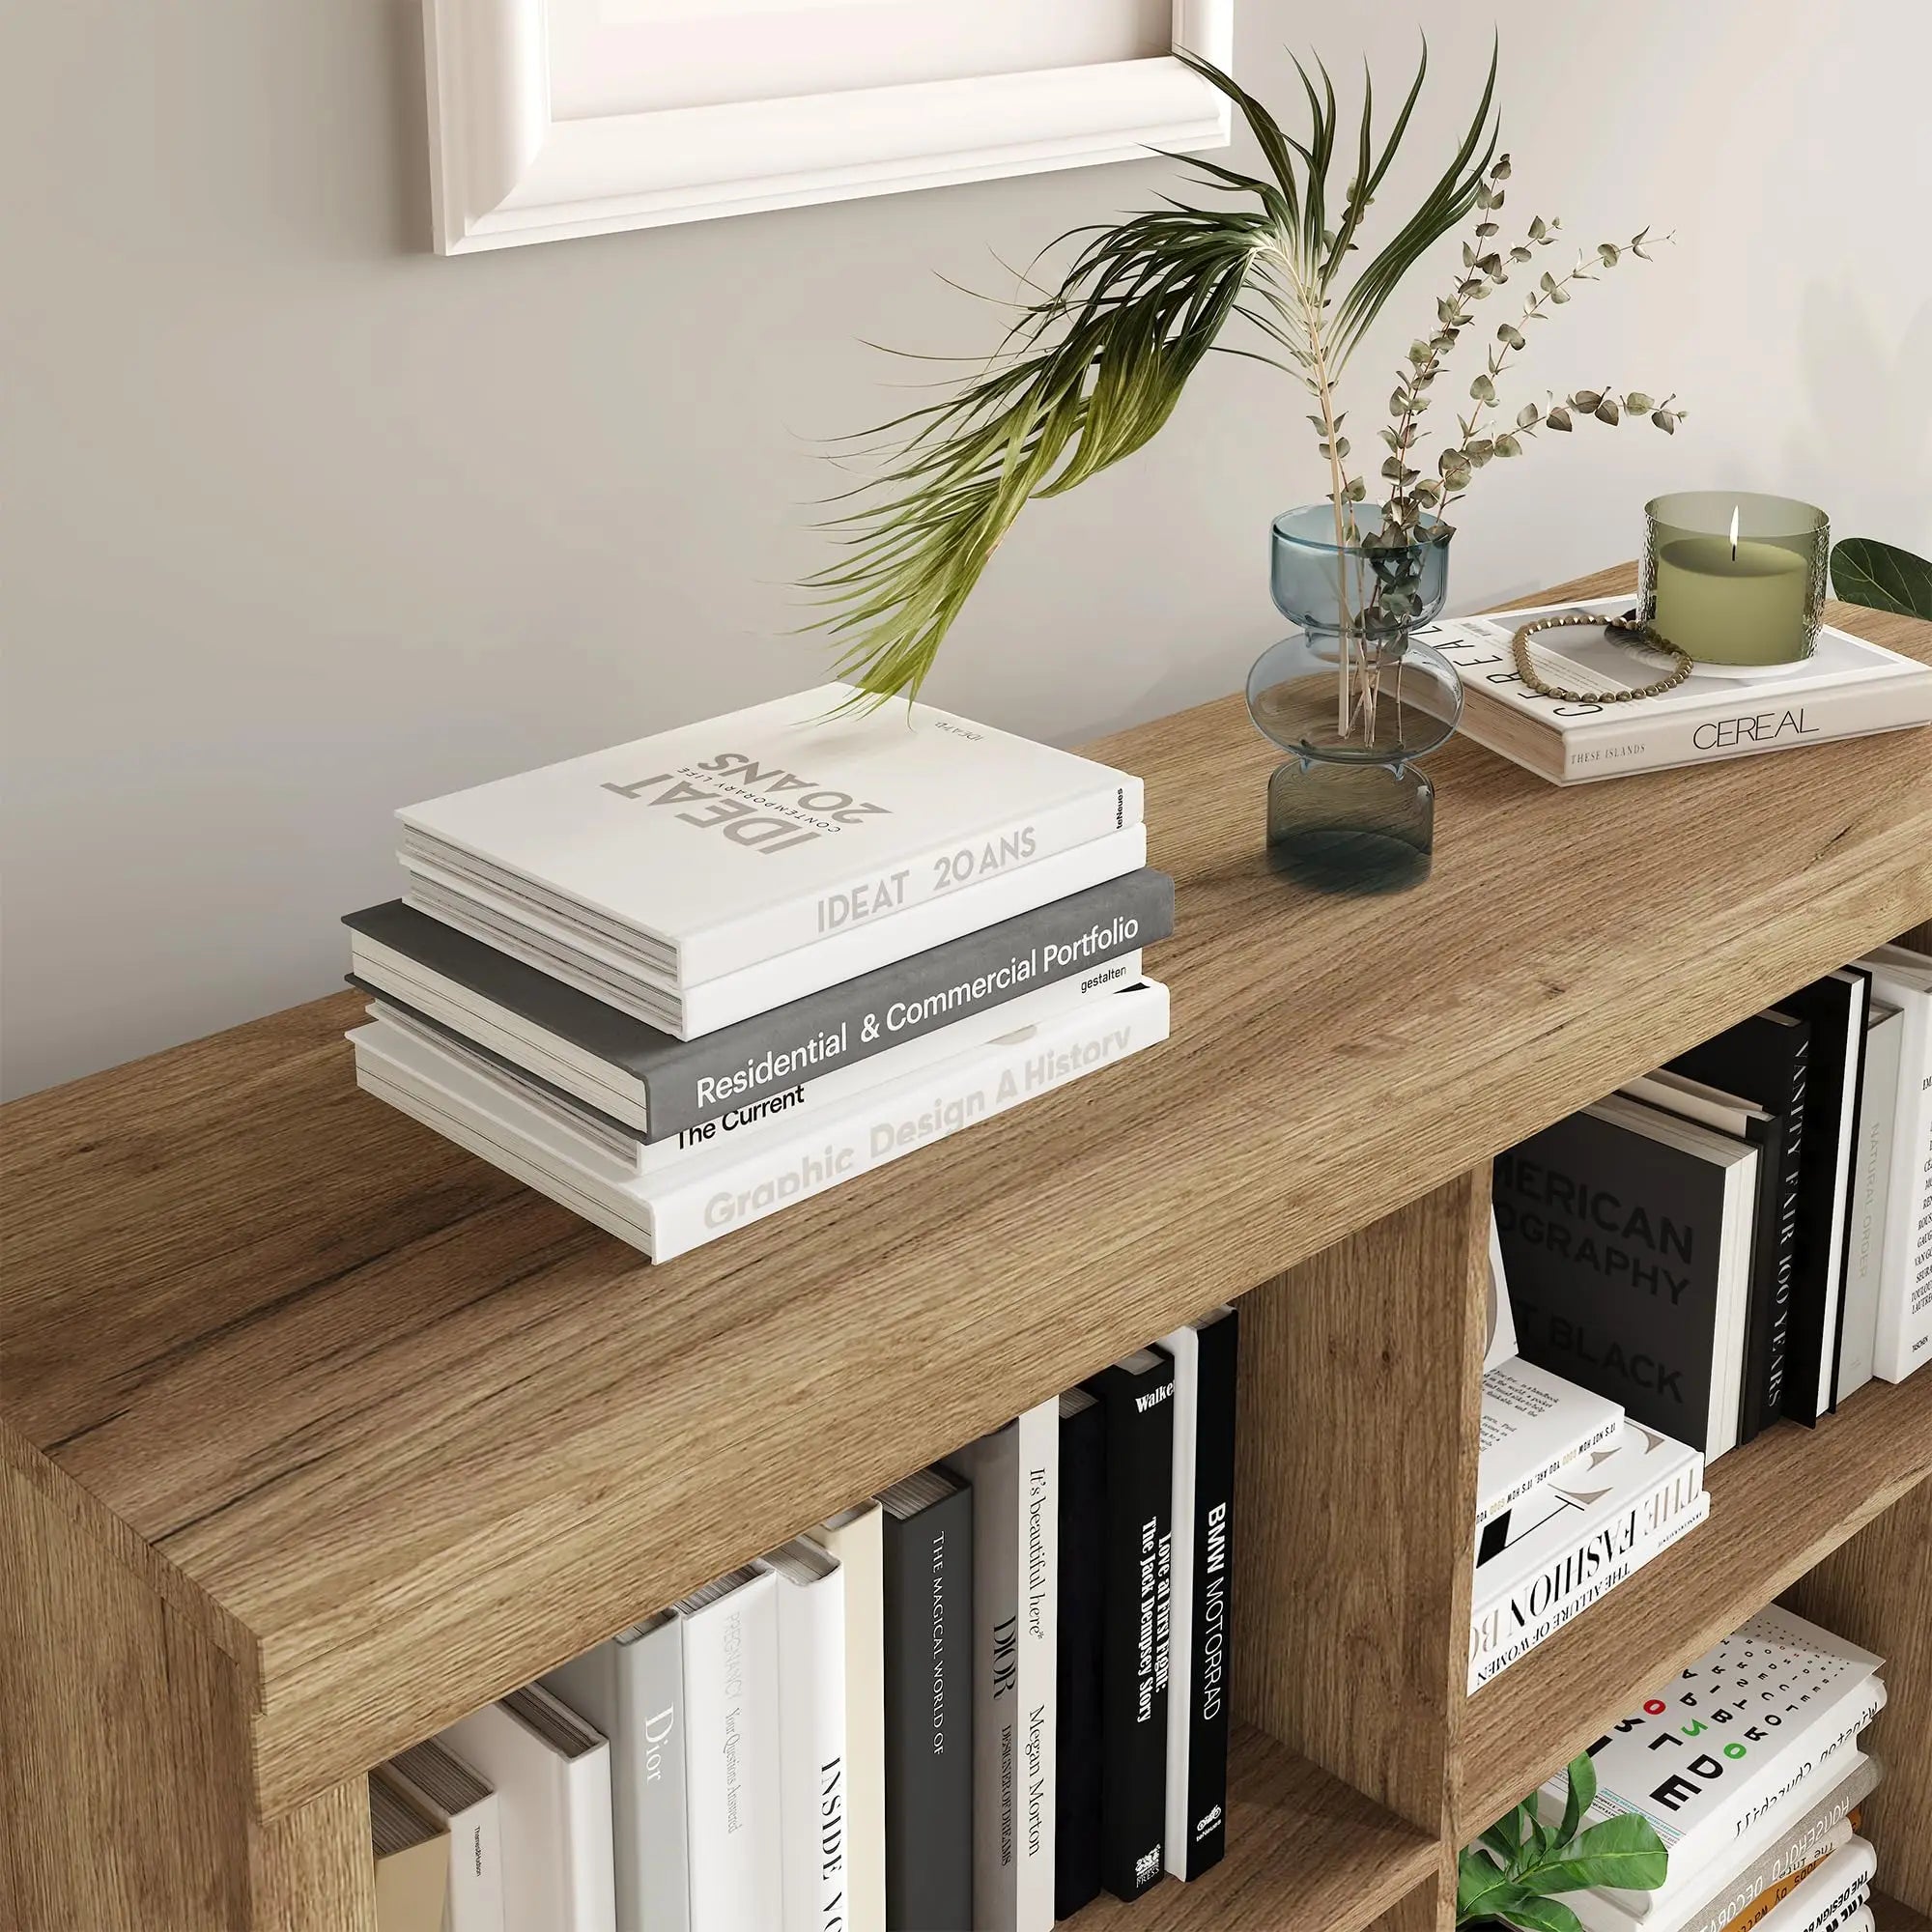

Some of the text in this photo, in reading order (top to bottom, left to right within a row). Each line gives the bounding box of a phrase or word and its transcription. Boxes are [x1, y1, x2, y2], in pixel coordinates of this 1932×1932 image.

[1571, 743, 1646, 765] THESE ISLANDS
[1693, 707, 1819, 751] CEREAL
[600, 776, 822, 855] IDEAT
[677, 767, 840, 833] CONTEMPORARY LIFE
[697, 753, 894, 824] 20 ANS
[1115, 788, 1124, 830] teNeues
[817, 826, 1037, 934] IDEAT 20 ANS
[696, 914, 1140, 1109] Residential & Commercial Portfolio
[1081, 965, 1127, 993] gestalten
[676, 1084, 805, 1151] The Current
[704, 1026, 1131, 1231] Graphic Design A History
[1787, 1039, 1809, 1156] VANITY
[1781, 1171, 1801, 1244] FAIR
[1859, 1122, 1879, 1279] NATURAL ORDER
[1549, 1316, 1683, 1405] BLACK
[1769, 1314, 1791, 1407] YEARS
[1578, 1439, 1592, 1455] HOW
[1593, 1432, 1604, 1446] NOT
[1030, 1467, 1046, 1496] It's
[1506, 1488, 1520, 1503] HOW
[1644, 1468, 1700, 1536] THE
[1029, 1496, 1047, 1590] beautiful
[1157, 1531, 1172, 1577] Love
[1506, 1510, 1636, 1638] FASHION
[1137, 1516, 1157, 1723] The Jack Dempsey Story
[1157, 1577, 1171, 1594] at
[1157, 1594, 1171, 1640] First
[1204, 1502, 1226, 1719] BMW MOTORRAD
[1477, 1562, 1631, 1686] THE ALLURE OF WOMEN
[724, 1611, 742, 1700] PREGNANCY
[933, 1530, 945, 1755] THE MAGICAL WORLD OF
[993, 1614, 1017, 1700] DIOR
[644, 1702, 674, 1785] Dior
[724, 1707, 743, 1833] Your Questions Answered
[1025, 1704, 1045, 1858] Megan Morton
[821, 1756, 843, 1881] INSIDE
[1002, 1724, 1012, 1866] DESIGNER OF DREAMS
[1196, 1818, 1222, 1842] teNeues
[1816, 1889, 1850, 1930] DESIGN
[1851, 1870, 1869, 1894] THE
